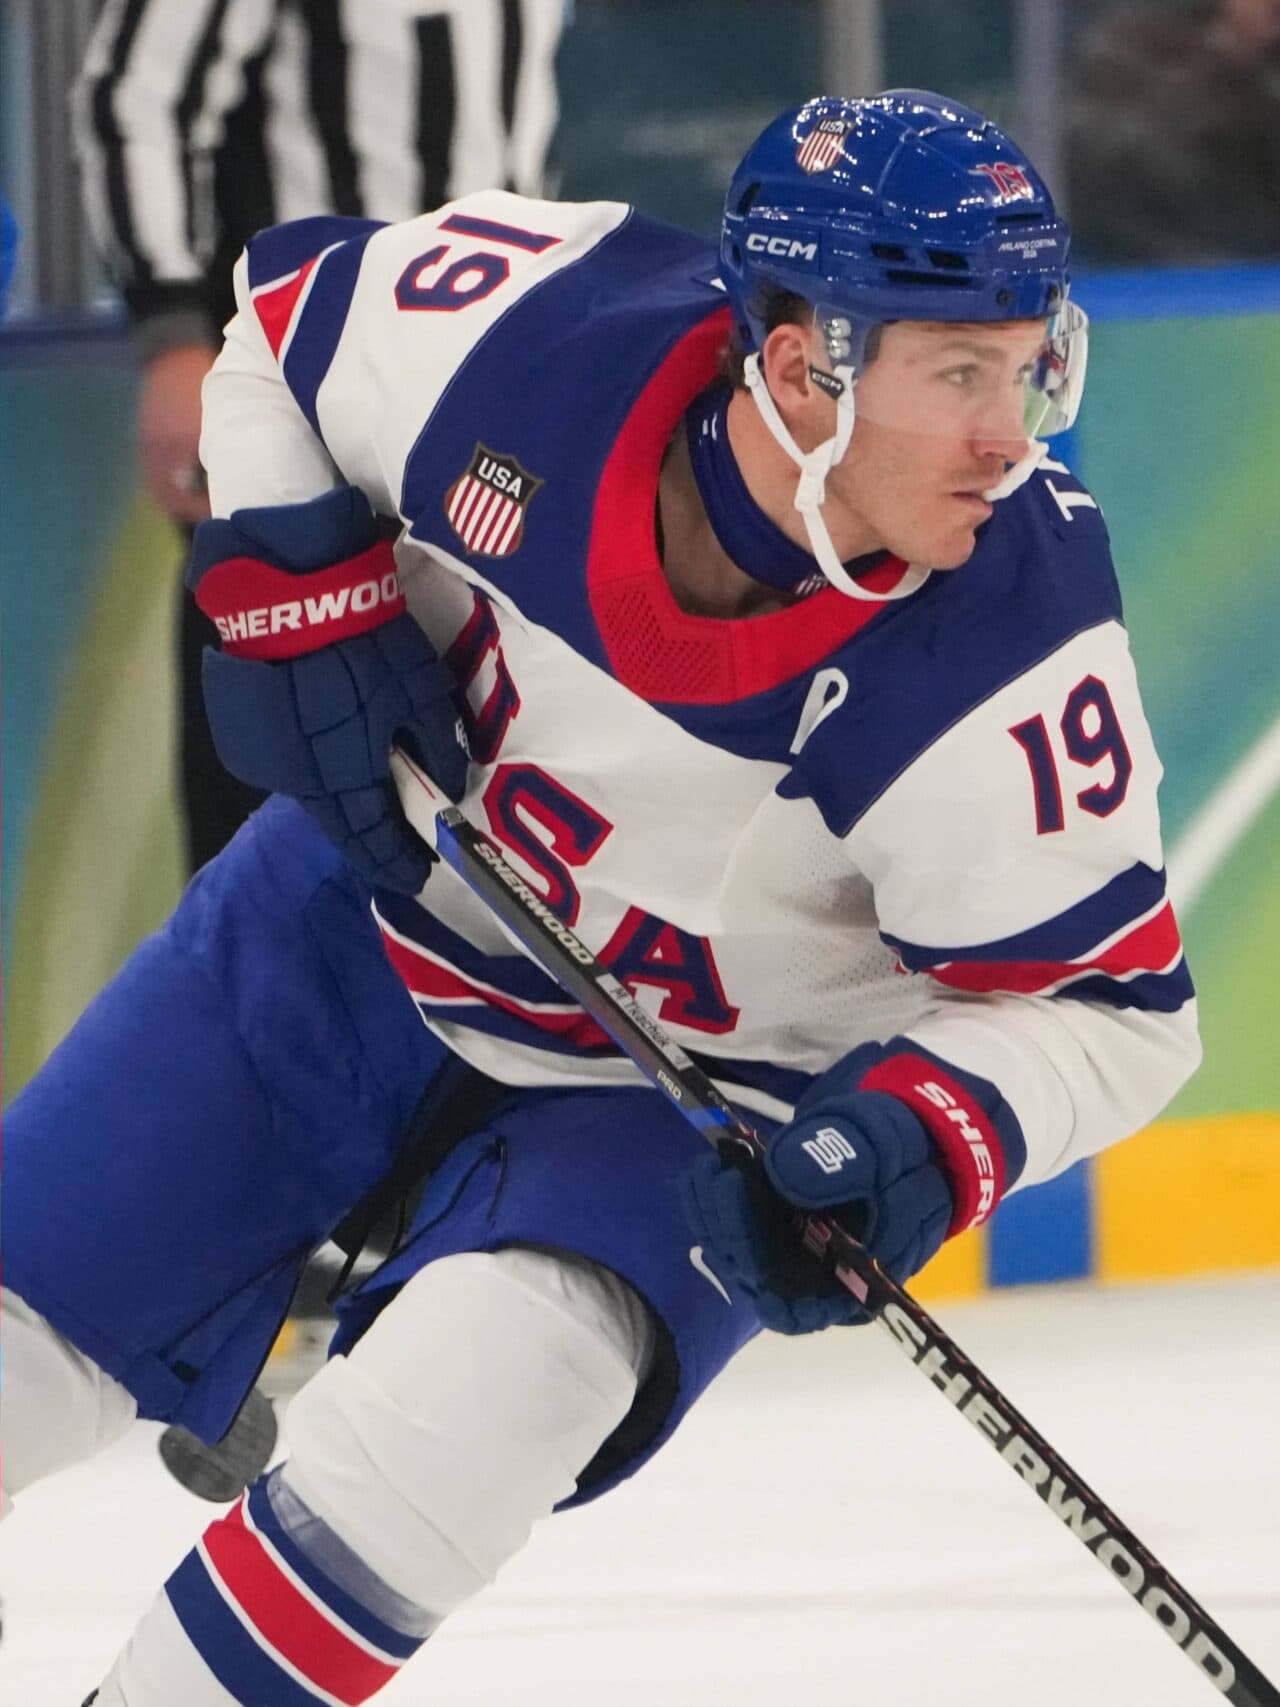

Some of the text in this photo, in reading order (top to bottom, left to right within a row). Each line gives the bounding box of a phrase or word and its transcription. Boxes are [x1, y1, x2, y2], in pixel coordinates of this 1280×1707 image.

[819, 120, 845, 134] USA
[973, 162, 1034, 201] 19
[393, 213, 564, 312] 19
[747, 234, 817, 261] CCM
[812, 371, 842, 391] CCM
[477, 457, 523, 499] USA
[215, 572, 404, 642] SHERWOO
[1008, 674, 1132, 835] 19
[473, 842, 595, 965] SHERWOOD
[657, 1069, 682, 1099] PRO
[876, 1302, 1236, 1694] SHERWOOD
